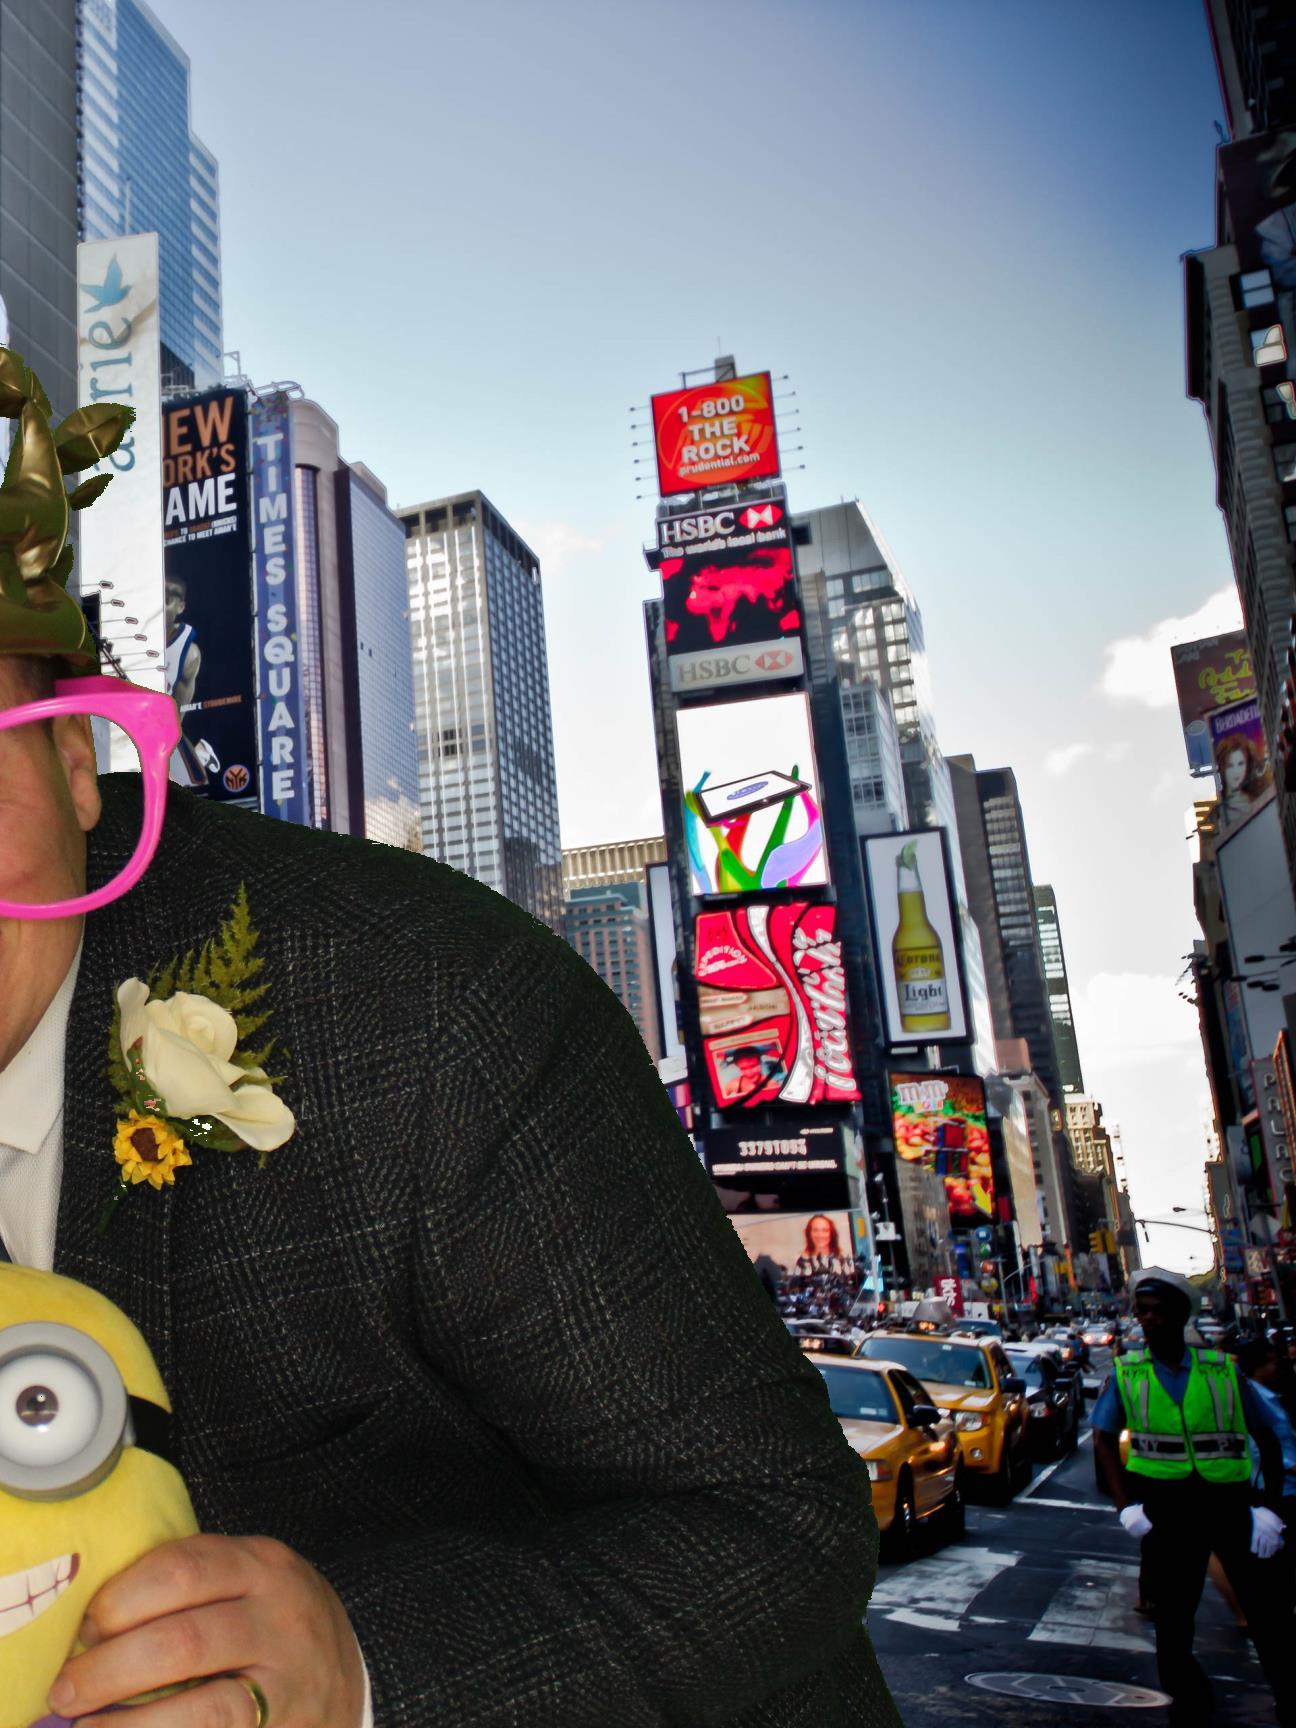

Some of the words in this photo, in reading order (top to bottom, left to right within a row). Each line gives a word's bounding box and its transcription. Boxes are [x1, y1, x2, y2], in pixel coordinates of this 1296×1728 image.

[84, 316, 136, 473] arie
[678, 394, 745, 423] 1-800
[161, 396, 234, 456] EW
[688, 416, 738, 441] THE
[682, 434, 751, 464] ROCK
[678, 453, 761, 478] prudential.com
[165, 472, 237, 526] AME
[256, 433, 287, 586] TIMES
[661, 511, 736, 545] HSBC
[756, 527, 787, 543] bank
[677, 654, 751, 681] HSBC
[264, 604, 296, 800] SQUARE
[905, 983, 943, 1001] Light
